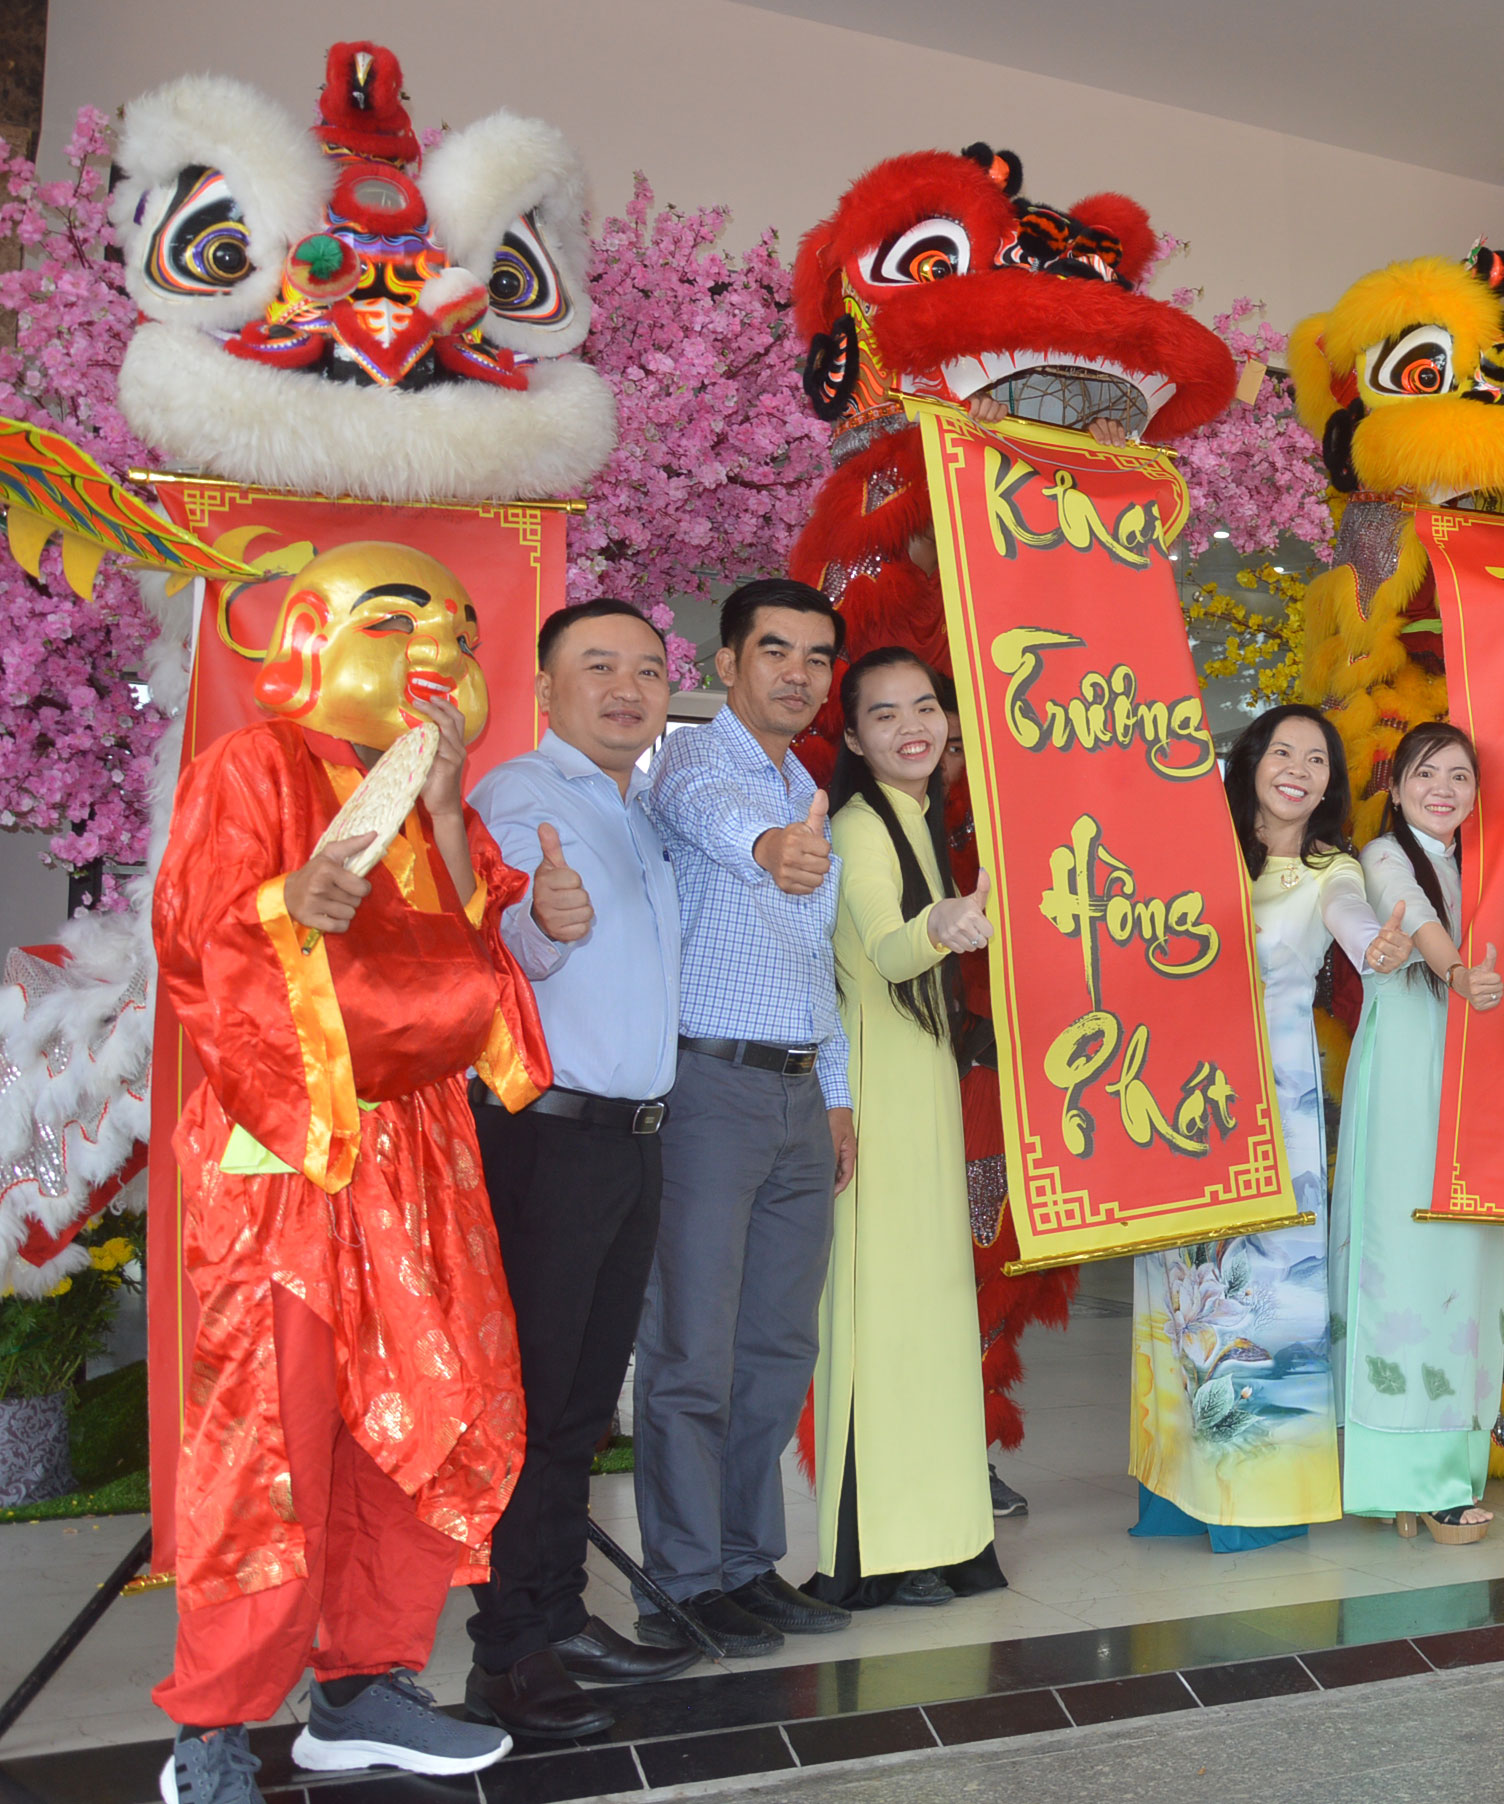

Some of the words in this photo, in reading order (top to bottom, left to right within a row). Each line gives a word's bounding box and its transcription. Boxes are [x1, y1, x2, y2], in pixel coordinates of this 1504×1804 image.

[983, 446, 1169, 567] Khai
[990, 626, 1216, 779] Trương
[1038, 813, 1221, 1013] Hồng
[1043, 1010, 1239, 1158] Phát
